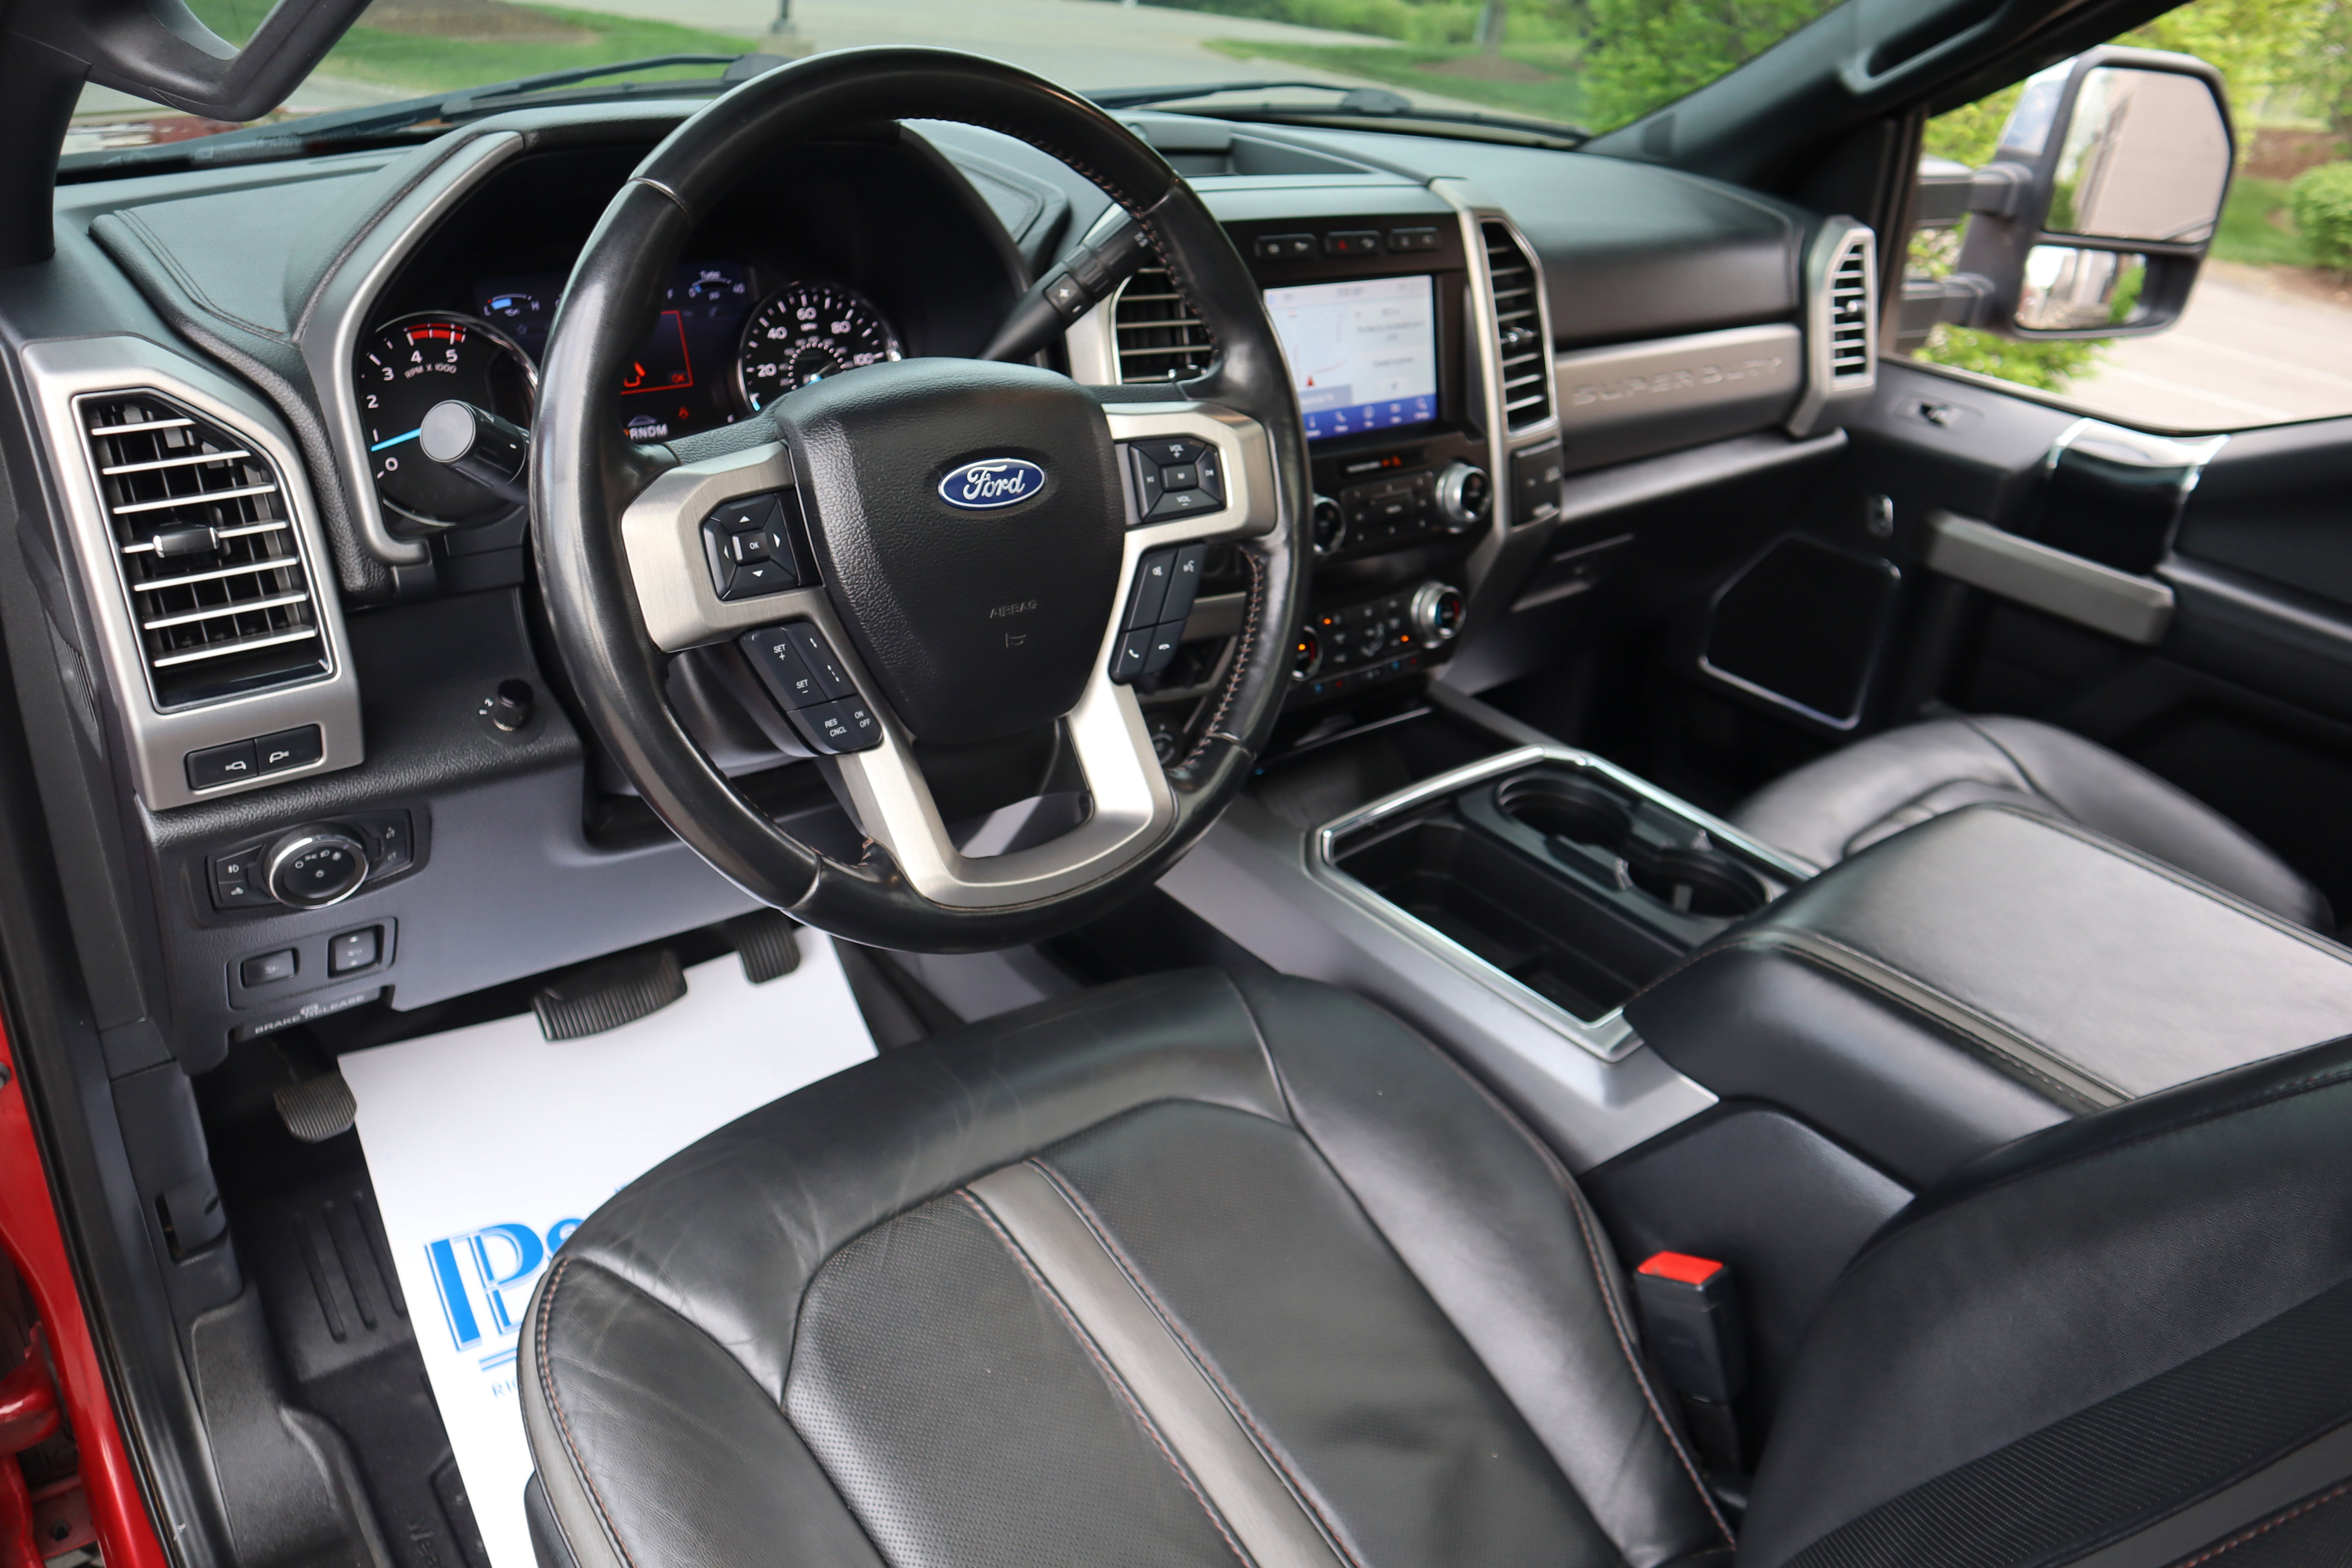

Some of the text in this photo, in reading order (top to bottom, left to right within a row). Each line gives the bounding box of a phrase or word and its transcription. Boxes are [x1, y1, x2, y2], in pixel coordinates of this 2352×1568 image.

[796, 307, 817, 321] 60
[767, 326, 788, 339] 40
[831, 320, 851, 334] 80
[411, 350, 423, 363] 4
[446, 349, 458, 363] 5
[382, 367, 394, 381] 3
[405, 365, 424, 379] RPM
[435, 363, 457, 374] 1000
[757, 363, 777, 377] 20
[367, 394, 379, 408] 2
[372, 429, 379, 442] 1
[385, 457, 398, 471] 0
[963, 465, 1026, 500] Ford
[749, 541, 760, 550] OK
[989, 600, 1038, 619] AIRBAG
[773, 644, 786, 653] SET
[796, 679, 808, 689] SET
[854, 710, 864, 719] ON
[824, 718, 837, 728] RES
[860, 718, 871, 728] OFF
[830, 726, 847, 737] CNCL
[255, 1014, 301, 1034] BRAKE
